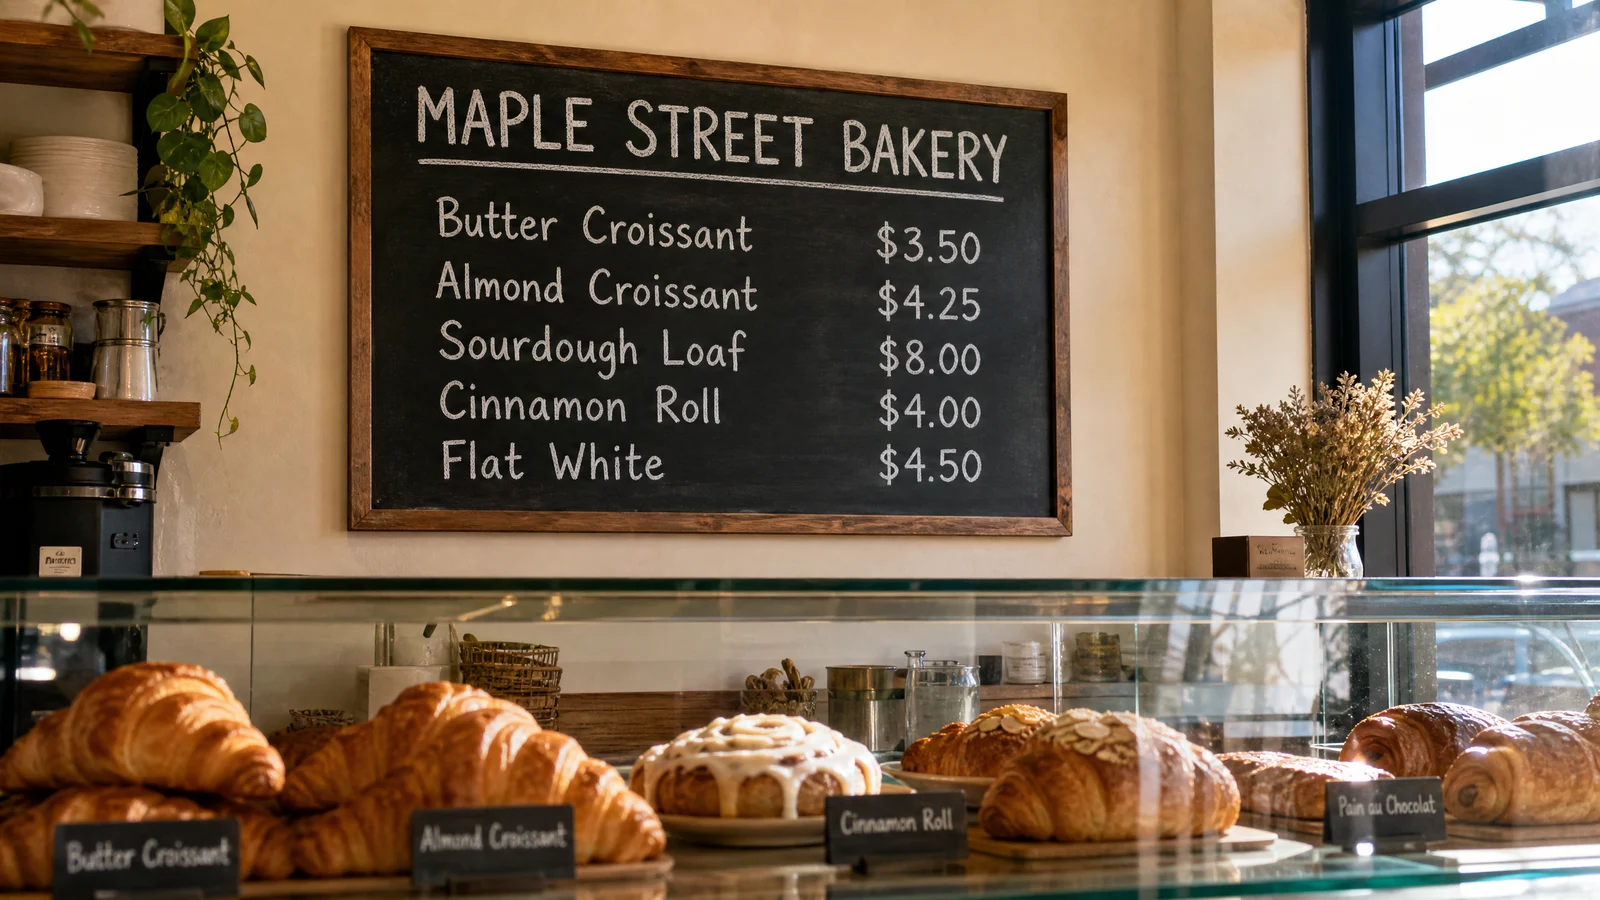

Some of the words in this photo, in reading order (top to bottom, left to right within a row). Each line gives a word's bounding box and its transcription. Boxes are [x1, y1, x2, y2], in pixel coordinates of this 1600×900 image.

[417, 85, 595, 153] MAPLE
[625, 99, 814, 168] STREET
[842, 119, 1008, 184] BAKERY
[436, 195, 558, 241] Butter
[582, 205, 753, 253] Croissant
[876, 220, 981, 265] $3.50
[435, 260, 565, 304] Almond
[588, 267, 758, 312] Croissant
[877, 279, 981, 322] $4.25
[439, 319, 638, 381] Sourdough
[662, 328, 747, 372] Loaf
[879, 334, 981, 377] $8.00
[439, 379, 627, 423] Cinnamon
[655, 384, 721, 425] Roll
[878, 388, 982, 432] $4.00
[442, 439, 525, 480] Flat
[549, 441, 664, 481] White
[879, 443, 982, 486] $4.50
[840, 810, 917, 835] Cinnamon
[922, 807, 954, 831] Roll
[1338, 795, 1365, 817] Pain
[1368, 801, 1383, 815] au
[1386, 794, 1436, 814] Chocolat
[66, 840, 135, 874] Butter
[142, 837, 231, 868] Croissant
[420, 824, 483, 852] Almond
[489, 822, 567, 849] Croissant
